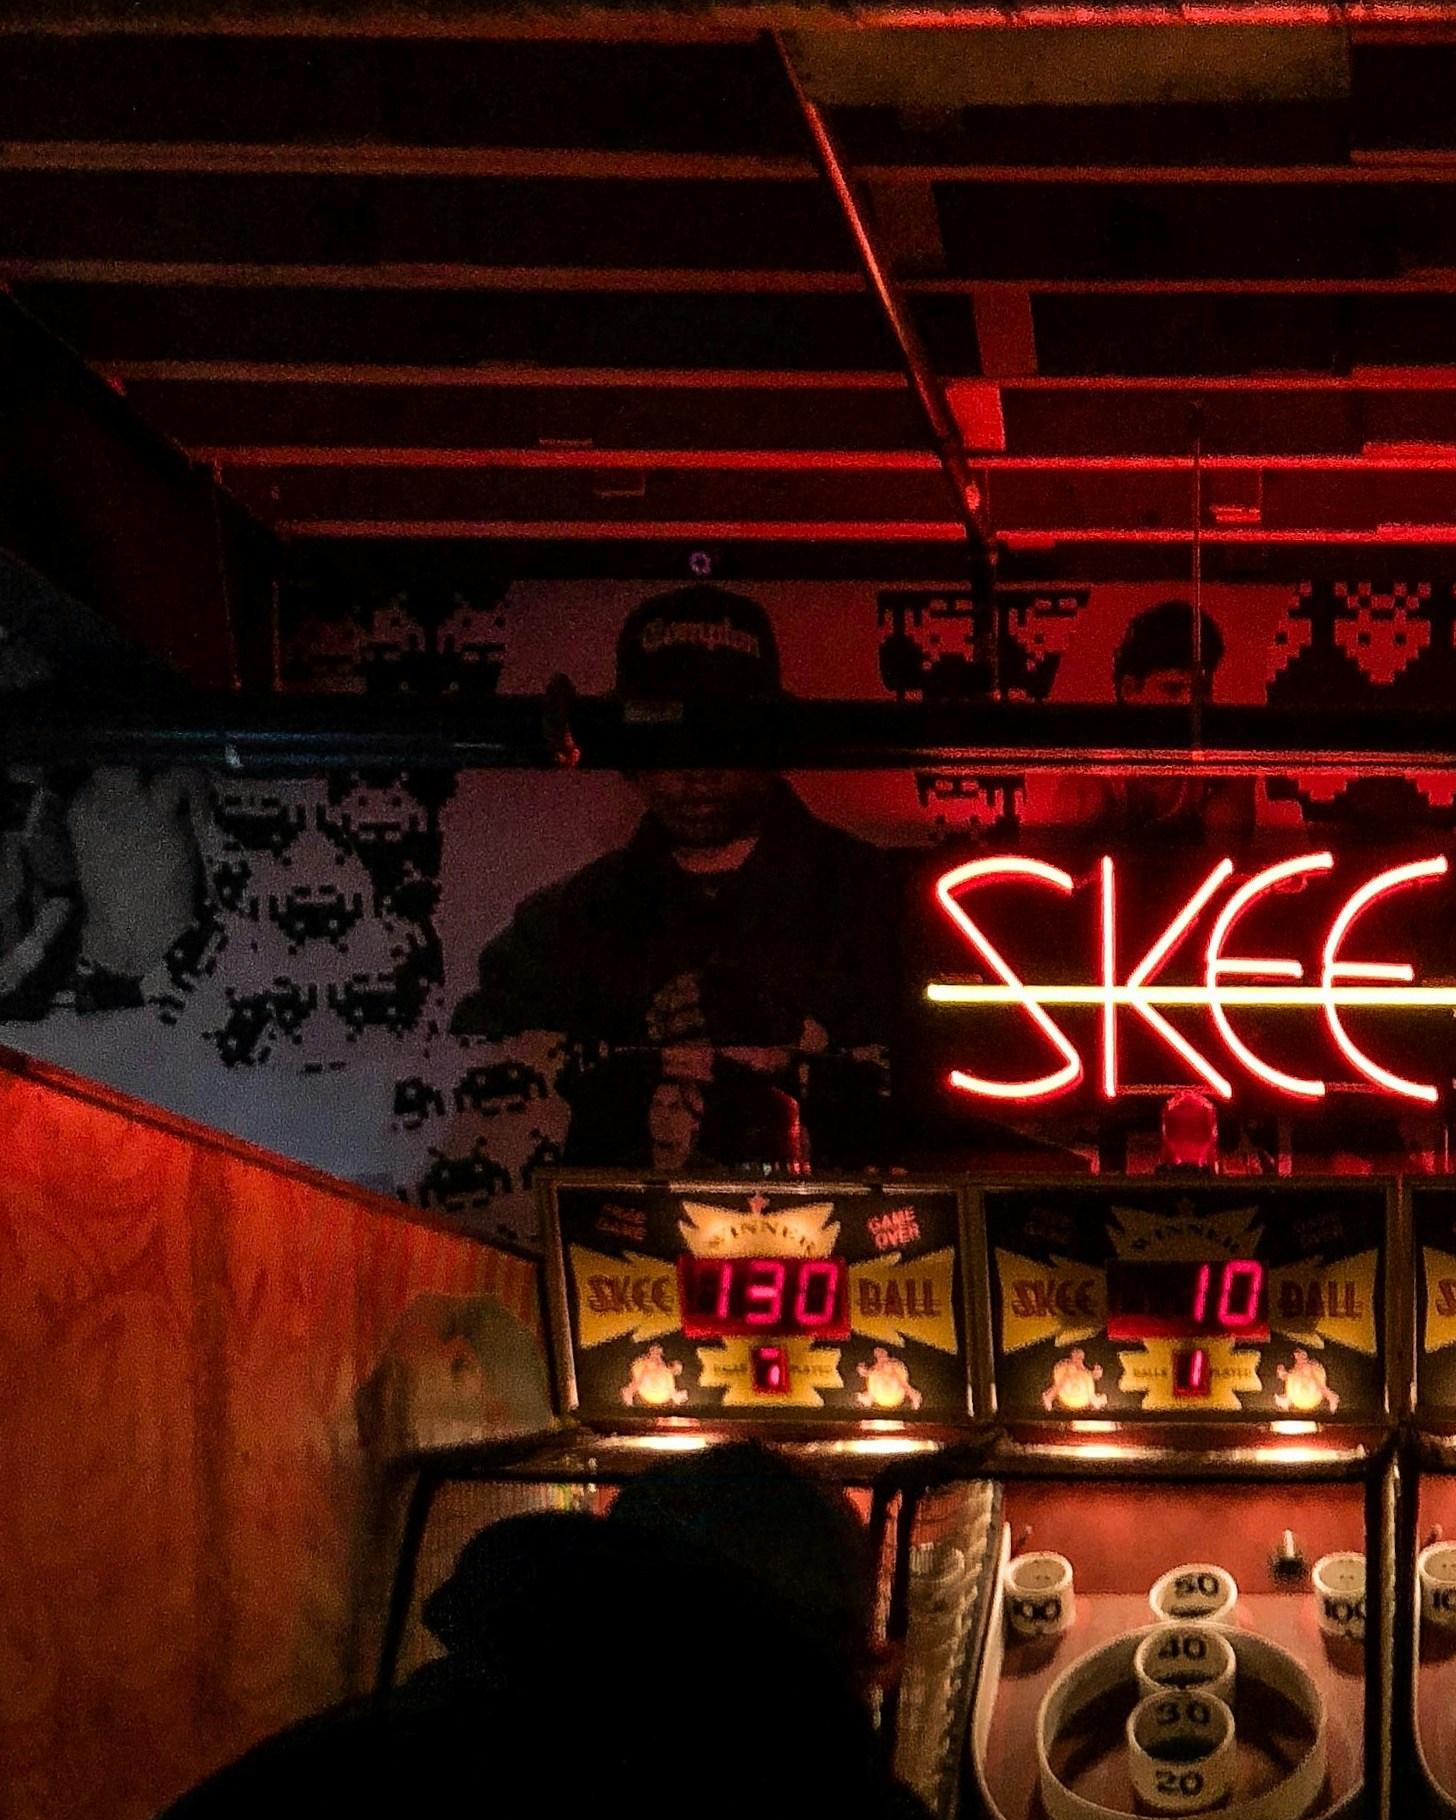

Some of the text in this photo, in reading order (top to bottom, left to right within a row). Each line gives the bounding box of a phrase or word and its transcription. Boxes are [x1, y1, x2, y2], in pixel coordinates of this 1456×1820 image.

[935, 851, 1450, 1103] SKEE
[867, 1205, 916, 1235] GAME
[874, 1222, 920, 1250] OVER
[712, 1259, 839, 1325] 130
[1193, 1259, 1263, 1326] 10
[1175, 1572, 1219, 1598] 50
[1158, 1637, 1207, 1661] 40
[1154, 1769, 1204, 1796] 20
